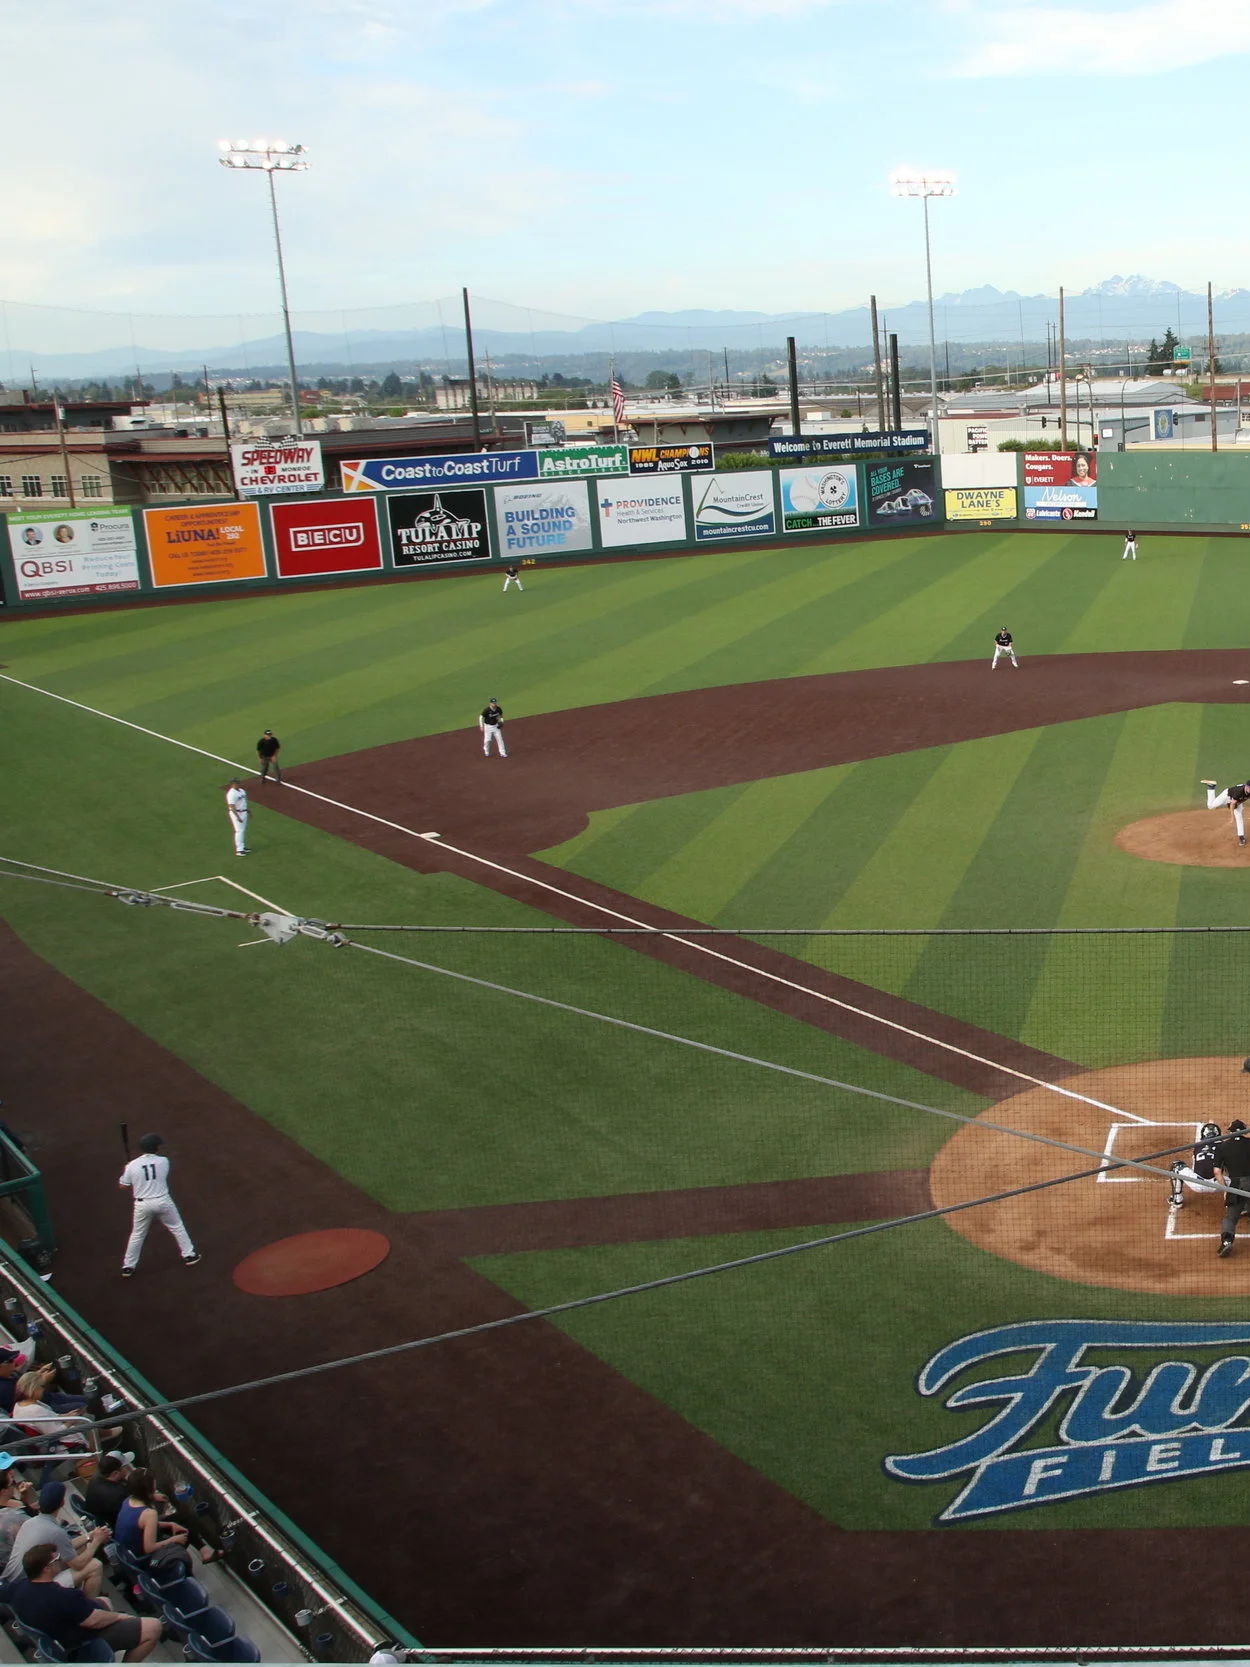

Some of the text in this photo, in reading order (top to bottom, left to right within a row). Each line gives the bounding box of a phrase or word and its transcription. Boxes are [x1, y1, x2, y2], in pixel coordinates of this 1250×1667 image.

[774, 435, 924, 452] Welcome to Everett Memorial Stadium
[241, 448, 313, 466] SPEEDWAY
[542, 453, 622, 471] AstroTurf
[632, 447, 709, 462] NWL CHAMPIONS
[1026, 463, 1053, 471] Cougars.
[241, 473, 319, 485] CHEVROLET
[871, 467, 904, 486] BASES ARE
[821, 475, 844, 495] WASHINGTON'S
[872, 479, 901, 496] COVERED.
[713, 494, 763, 503] MountainCrest
[826, 492, 846, 505] LOTTERY
[957, 491, 1004, 500] DWAYNE
[1042, 486, 1082, 501] Nelson
[617, 496, 681, 508] PROVIDENCE
[962, 500, 1000, 508] LANE'S
[505, 507, 575, 522] BUILDING
[618, 514, 682, 524] Northwest Washington
[817, 517, 832, 526] THE
[833, 515, 855, 525] FEVER
[167, 528, 219, 543] LiUNA!
[220, 525, 244, 533] LOCAL
[398, 522, 481, 544] TULALIP
[507, 520, 572, 536] A SOUND
[703, 524, 768, 535] mountaincrestcu.com
[403, 540, 479, 554] RESORT CASINO
[507, 533, 565, 549] FUTURE
[413, 551, 472, 561] TULALIPCASINO.COM
[21, 560, 72, 578] QBSI
[142, 1164, 156, 1180] 11
